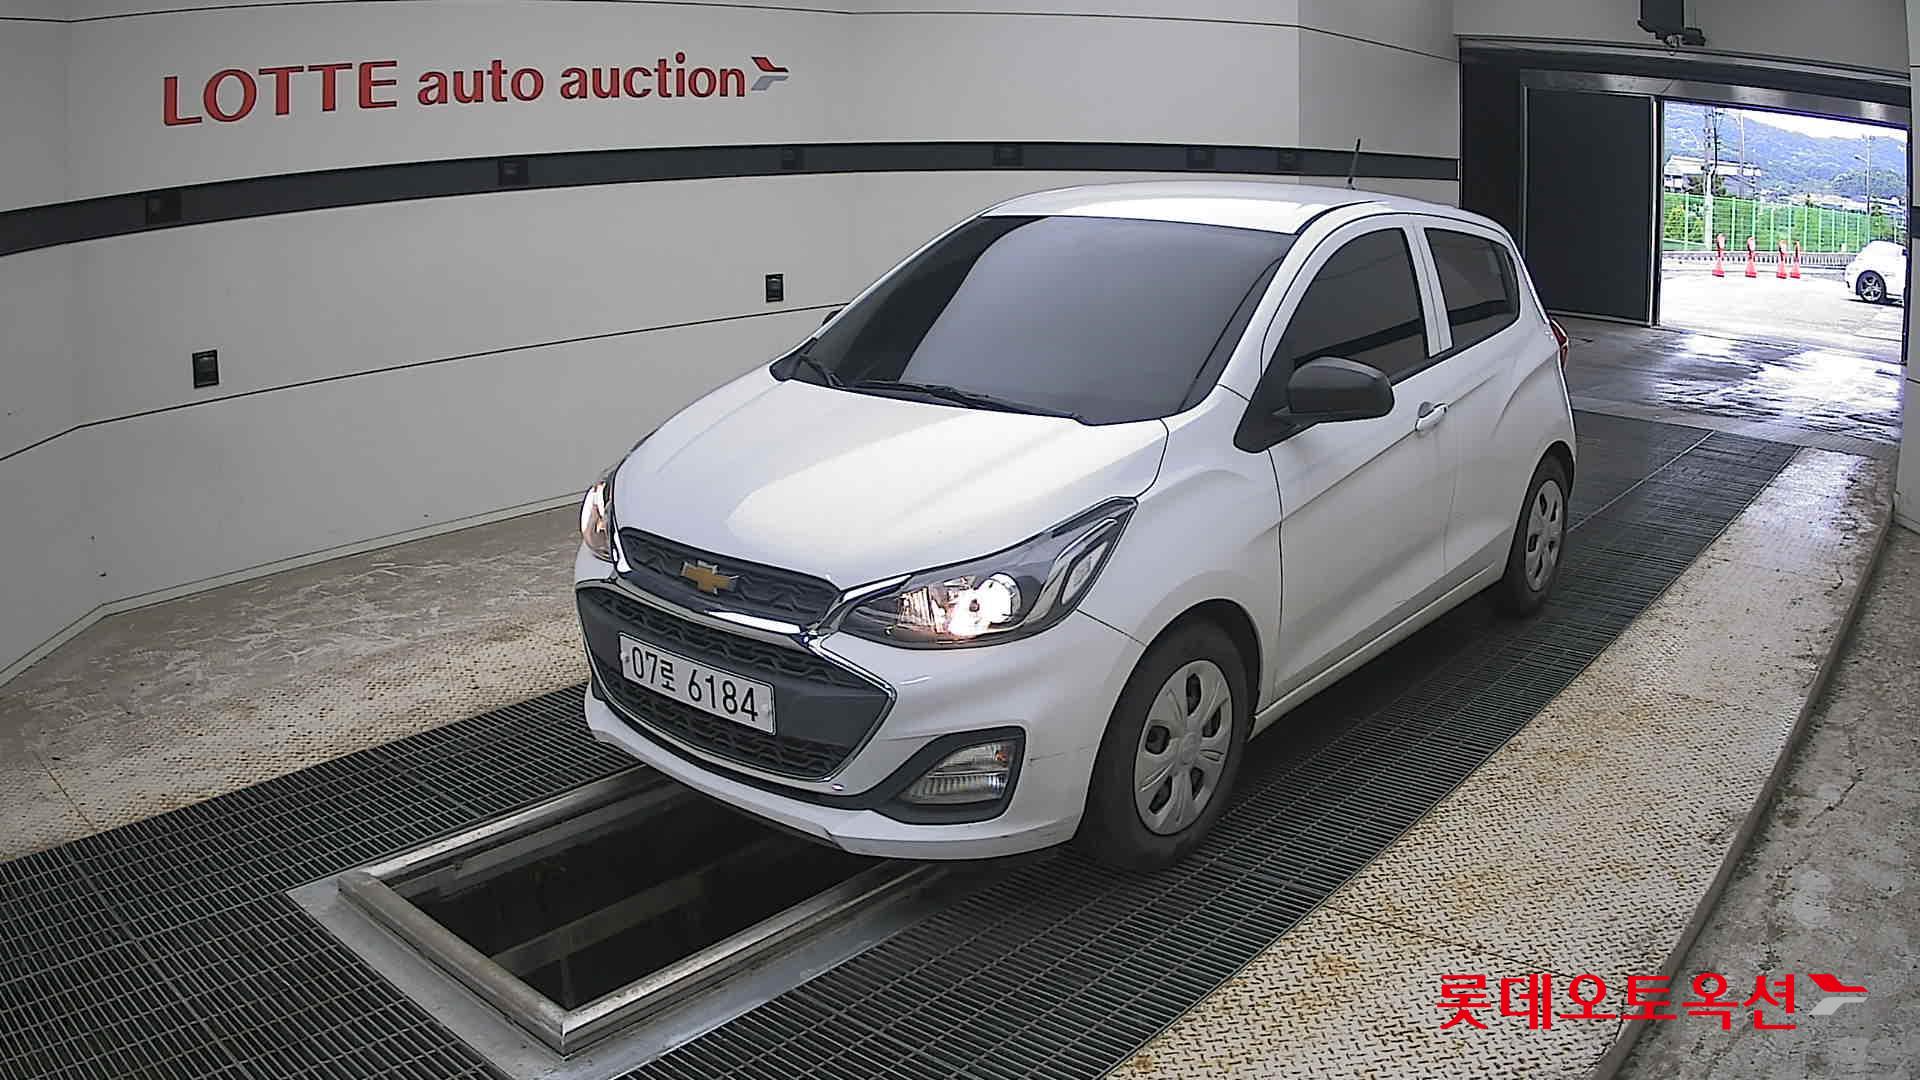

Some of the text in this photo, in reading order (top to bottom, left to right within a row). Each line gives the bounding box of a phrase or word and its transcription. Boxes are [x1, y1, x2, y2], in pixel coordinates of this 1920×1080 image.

[163, 52, 746, 126] LOTTE auto auction
[631, 646, 758, 722] 07로 6184
